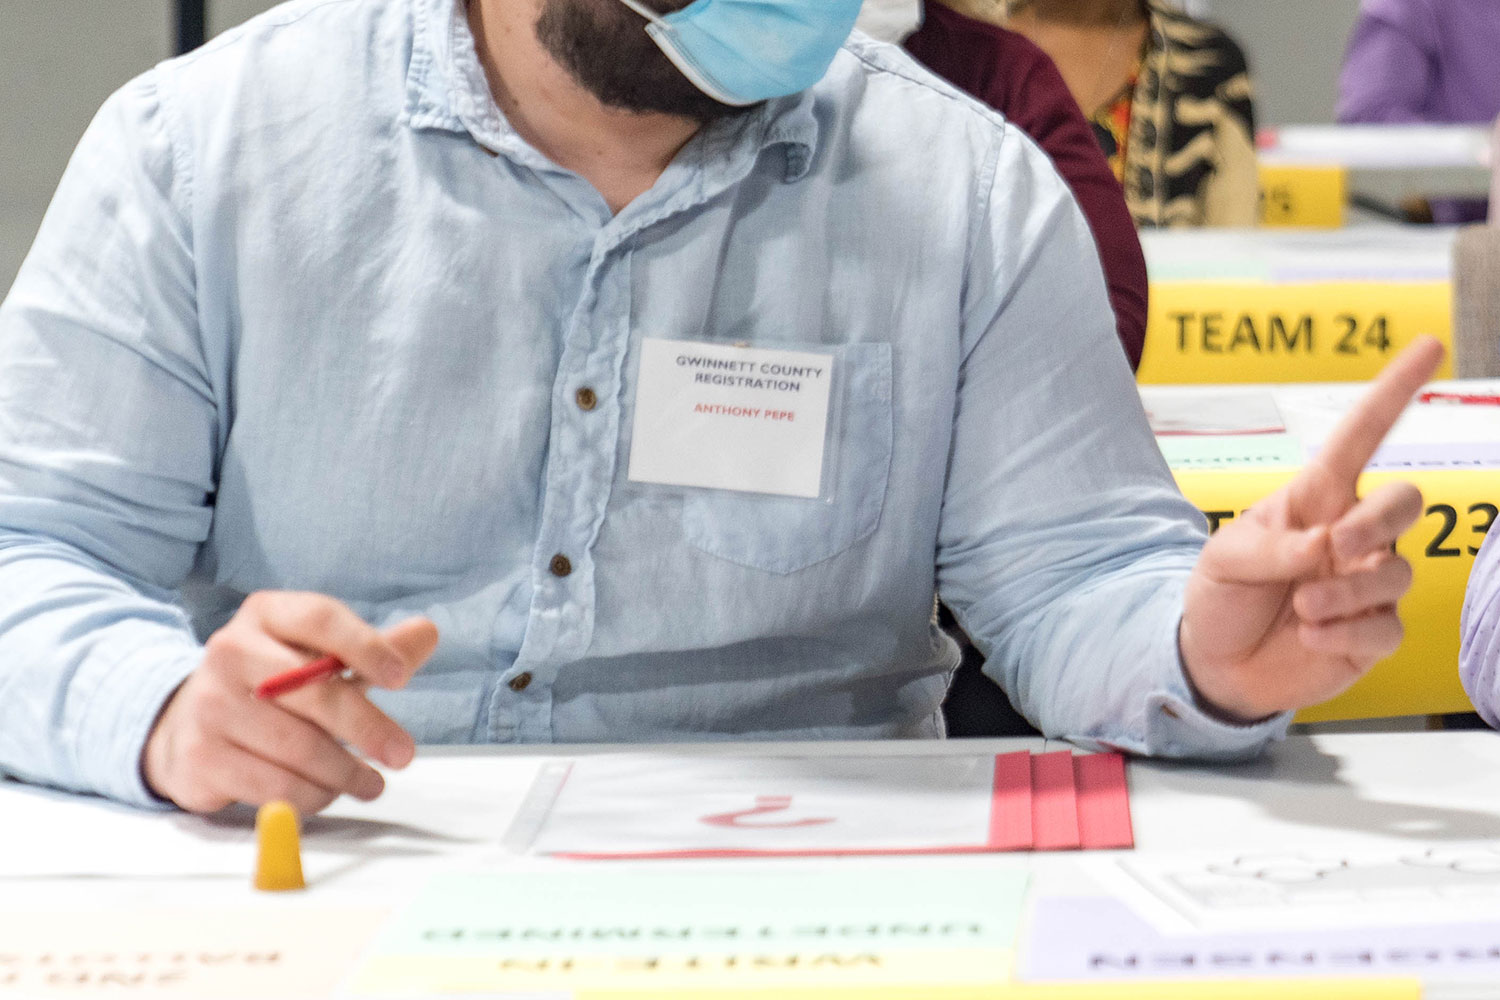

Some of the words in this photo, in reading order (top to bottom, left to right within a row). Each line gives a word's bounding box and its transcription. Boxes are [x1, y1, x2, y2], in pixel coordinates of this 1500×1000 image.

[1169, 312, 1314, 354] TEAM
[1335, 315, 1391, 354] 24
[676, 355, 756, 374] GWINNETT
[760, 363, 823, 378] COUNTY
[694, 372, 801, 392] REGISTRATION
[693, 403, 761, 418] ANTHONY
[764, 409, 796, 422] PEPE
[1424, 503, 1498, 558] 23
[417, 922, 987, 943] UNDETERMINED
[614, 952, 884, 972] WRITE
